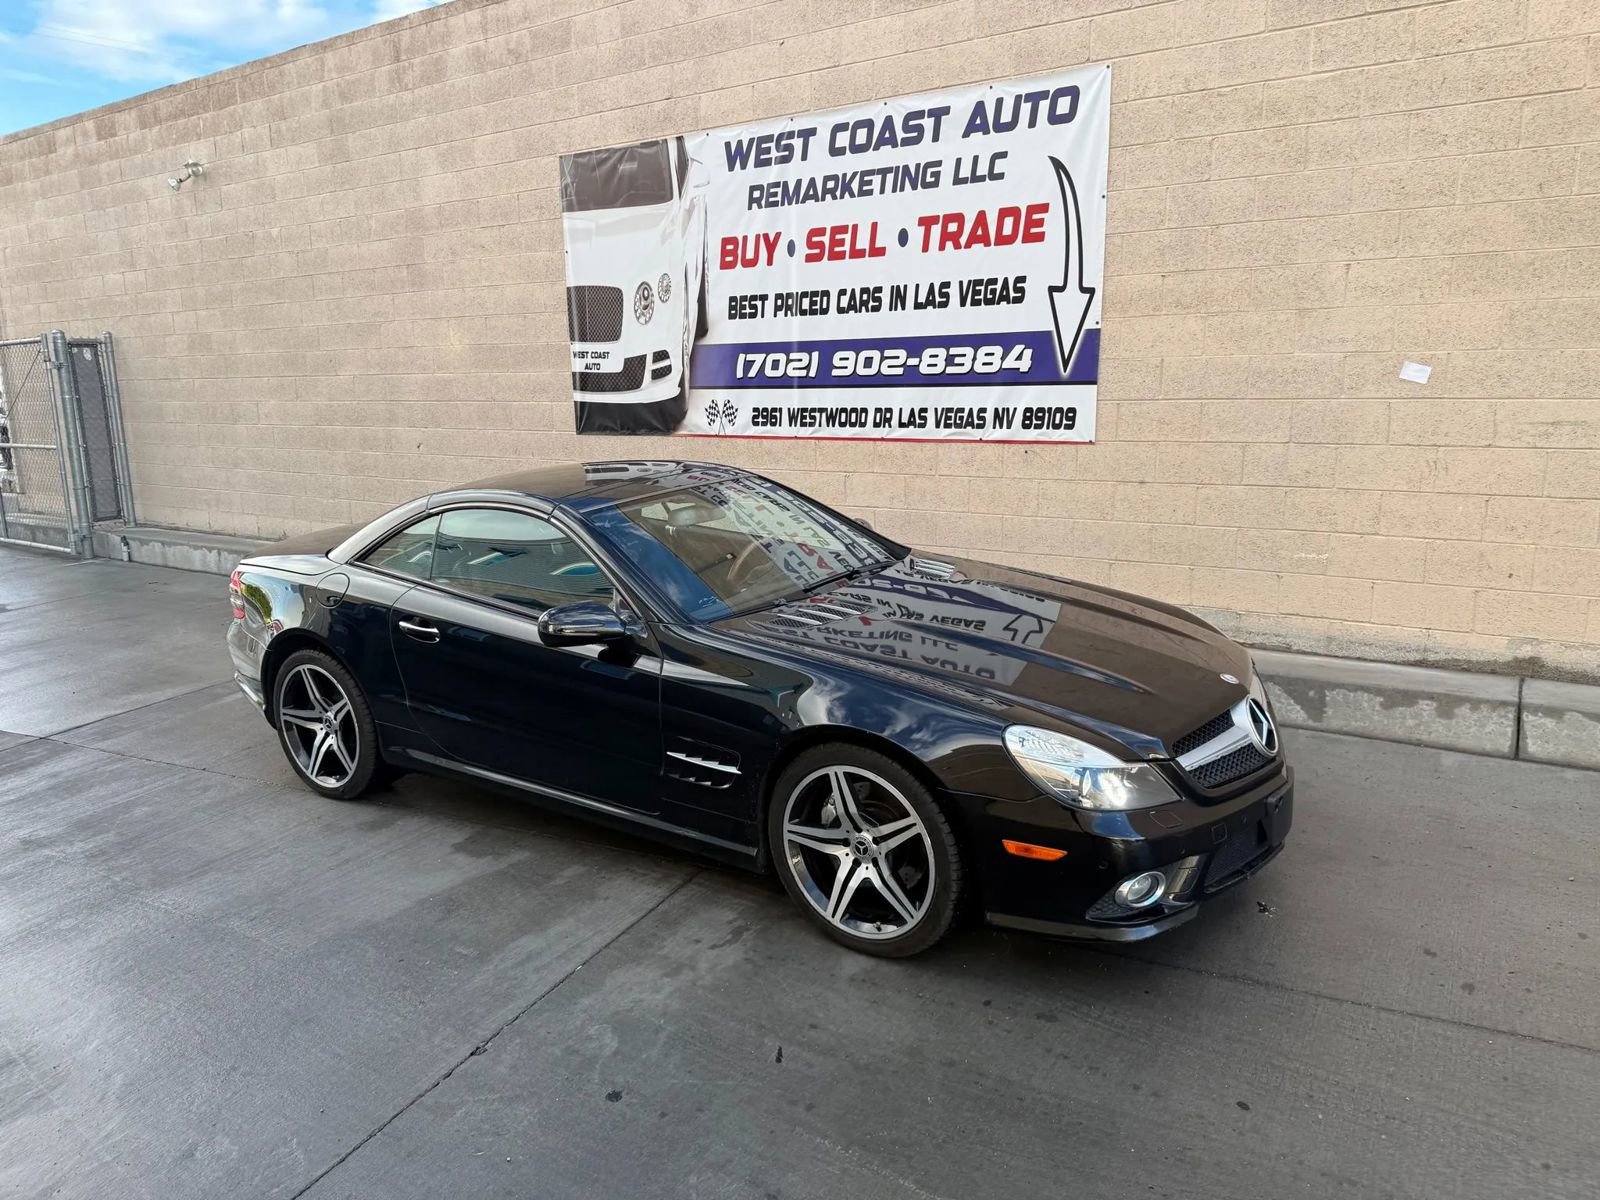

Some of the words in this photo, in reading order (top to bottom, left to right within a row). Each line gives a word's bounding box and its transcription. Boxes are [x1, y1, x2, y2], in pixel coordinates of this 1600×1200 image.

[724, 127, 817, 172] WEST
[828, 105, 951, 157] COAST
[961, 85, 1081, 138] AUTO
[747, 160, 942, 211] REMARKETING
[952, 151, 1008, 186] LLC
[719, 231, 781, 270] BUY
[804, 221, 887, 263] SELL
[916, 203, 1050, 253] TRADE
[728, 294, 768, 320] BEST
[773, 289, 830, 318] PRICED
[835, 287, 883, 315] CARS
[889, 284, 908, 311] IN
[913, 281, 951, 309] LAS
[958, 275, 1026, 306] VEGAS
[573, 351, 589, 359] WEST
[590, 351, 610, 359] COAST
[736, 351, 819, 380] (702)
[831, 344, 1033, 377] 902-8384
[751, 407, 783, 427] 2961
[787, 407, 870, 429] WESTWOOD
[873, 407, 893, 429] DR
[898, 407, 928, 429] LAS
[934, 407, 987, 430] VEGAS
[992, 407, 1016, 430] NV
[1021, 407, 1077, 430] 89109
